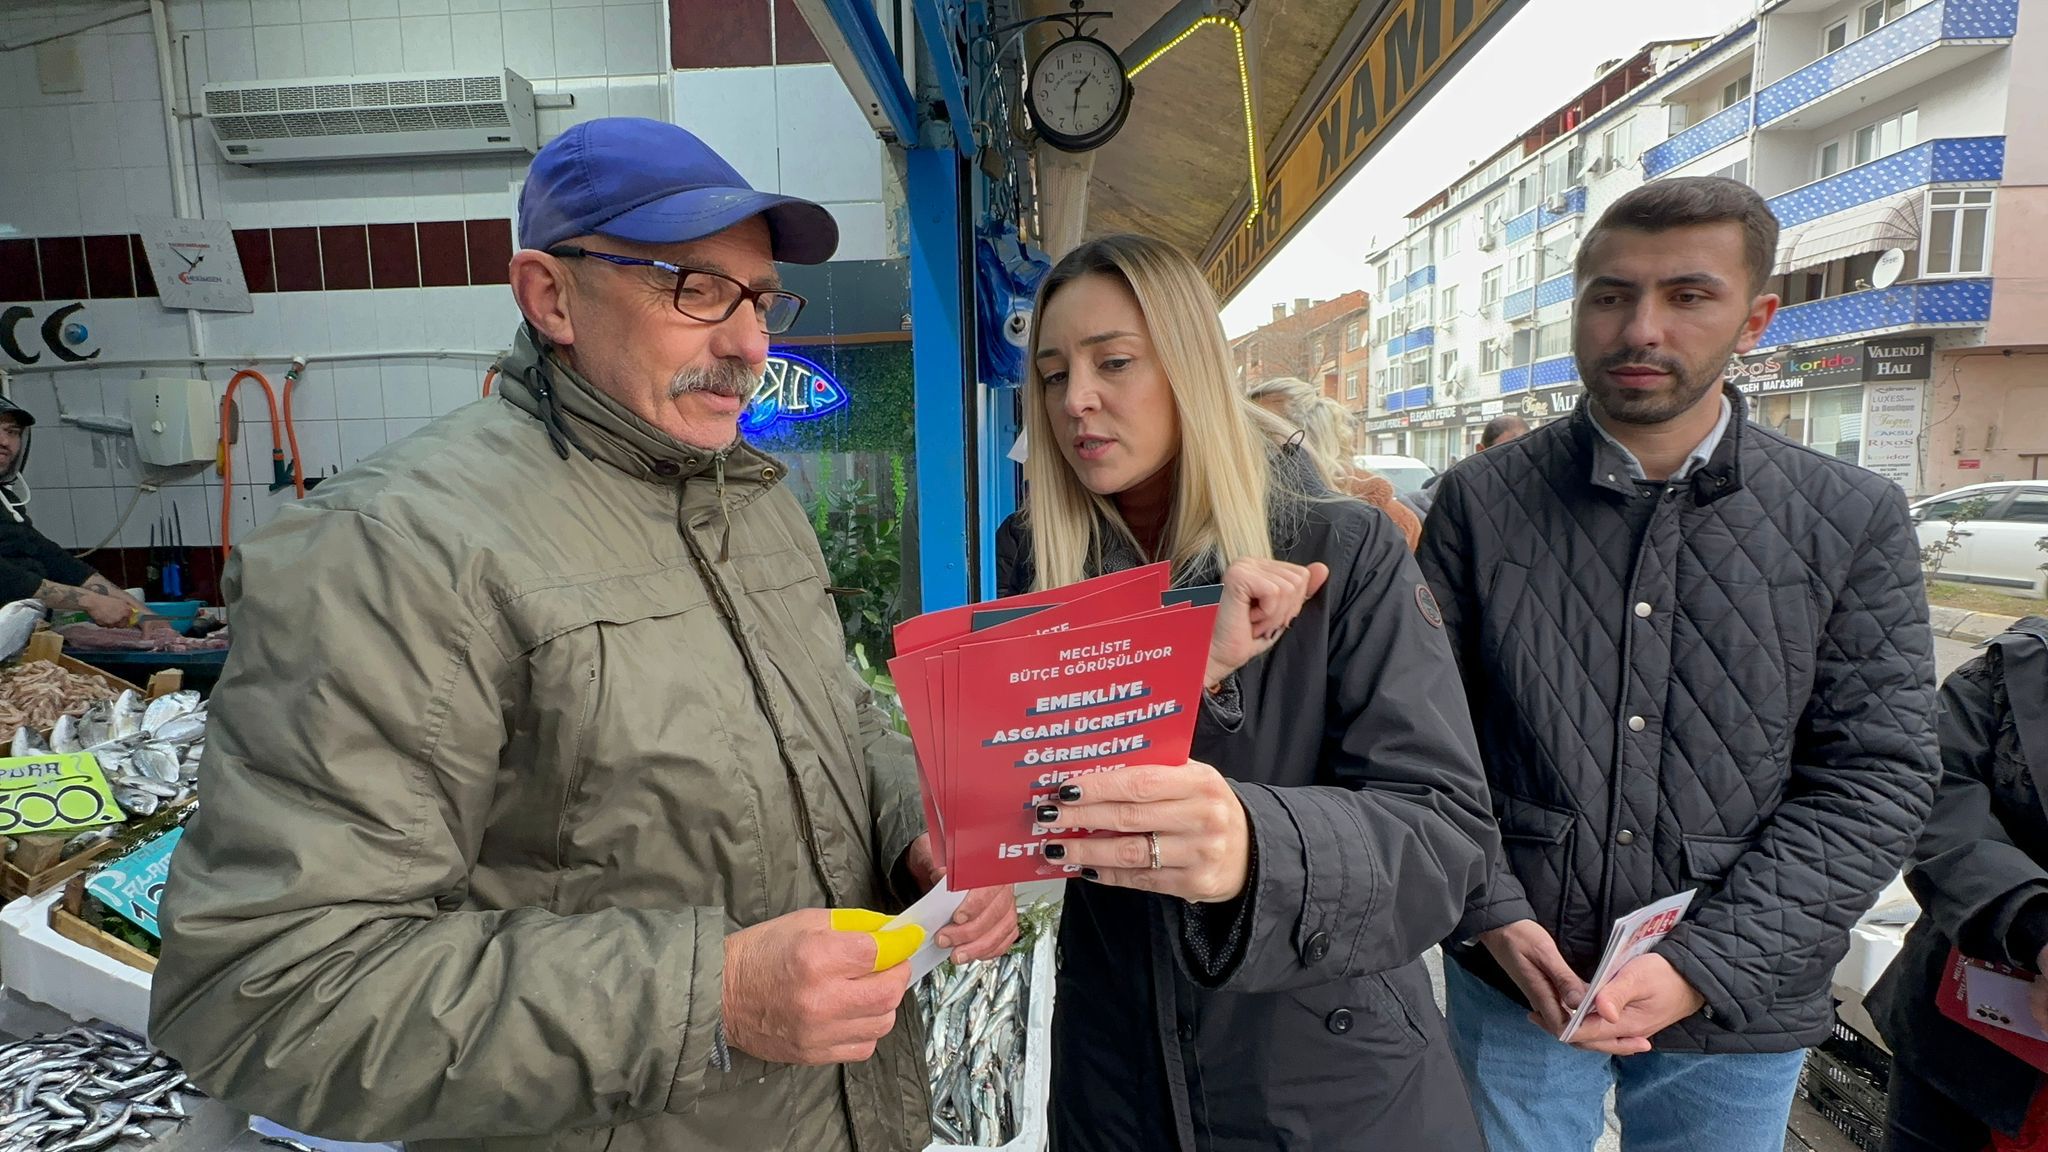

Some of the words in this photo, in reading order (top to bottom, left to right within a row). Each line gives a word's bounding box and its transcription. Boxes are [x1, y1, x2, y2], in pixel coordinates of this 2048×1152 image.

[1867, 343, 1925, 359] VALENDİ
[1790, 353, 1859, 373] korido
[1877, 361, 1912, 376] HALI
[1762, 378, 1804, 391] МАГАЗИН
[1059, 639, 1132, 661] MECLİSTE
[1009, 667, 1060, 684] BÜTÇE
[1064, 646, 1173, 676] GÖRÜŞÜLÜYOR
[1036, 680, 1144, 713] EMEKLİYE
[992, 719, 1070, 744] ASGARİ
[1075, 699, 1177, 733] ÜCRETLİYE
[1023, 734, 1145, 765] ÖĞRENCİYE
